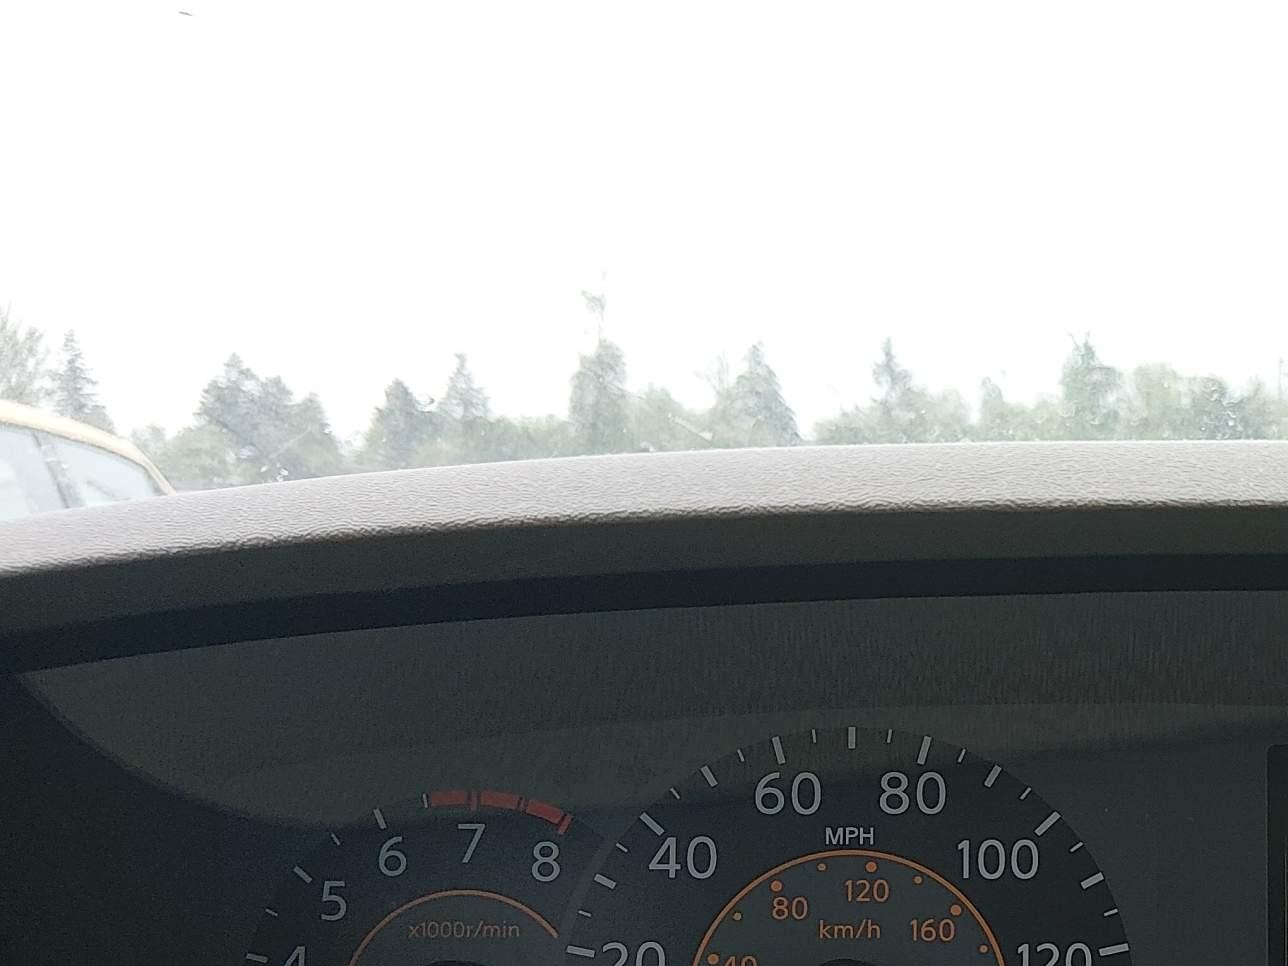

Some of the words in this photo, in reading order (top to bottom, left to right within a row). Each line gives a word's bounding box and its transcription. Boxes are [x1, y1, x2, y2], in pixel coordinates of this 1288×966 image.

[754, 772, 821, 815] 60
[879, 772, 946, 815] 80
[457, 824, 486, 863] 7
[825, 827, 875, 846] MPH
[378, 837, 407, 877] 6
[531, 841, 561, 881] 8
[648, 836, 717, 880] 40
[957, 839, 1038, 880] 100
[320, 880, 347, 920] 5
[772, 898, 808, 920] 80
[844, 880, 889, 903] 120
[408, 920, 520, 939] x1000r/min
[819, 920, 880, 940] km/h
[910, 919, 955, 943] 160
